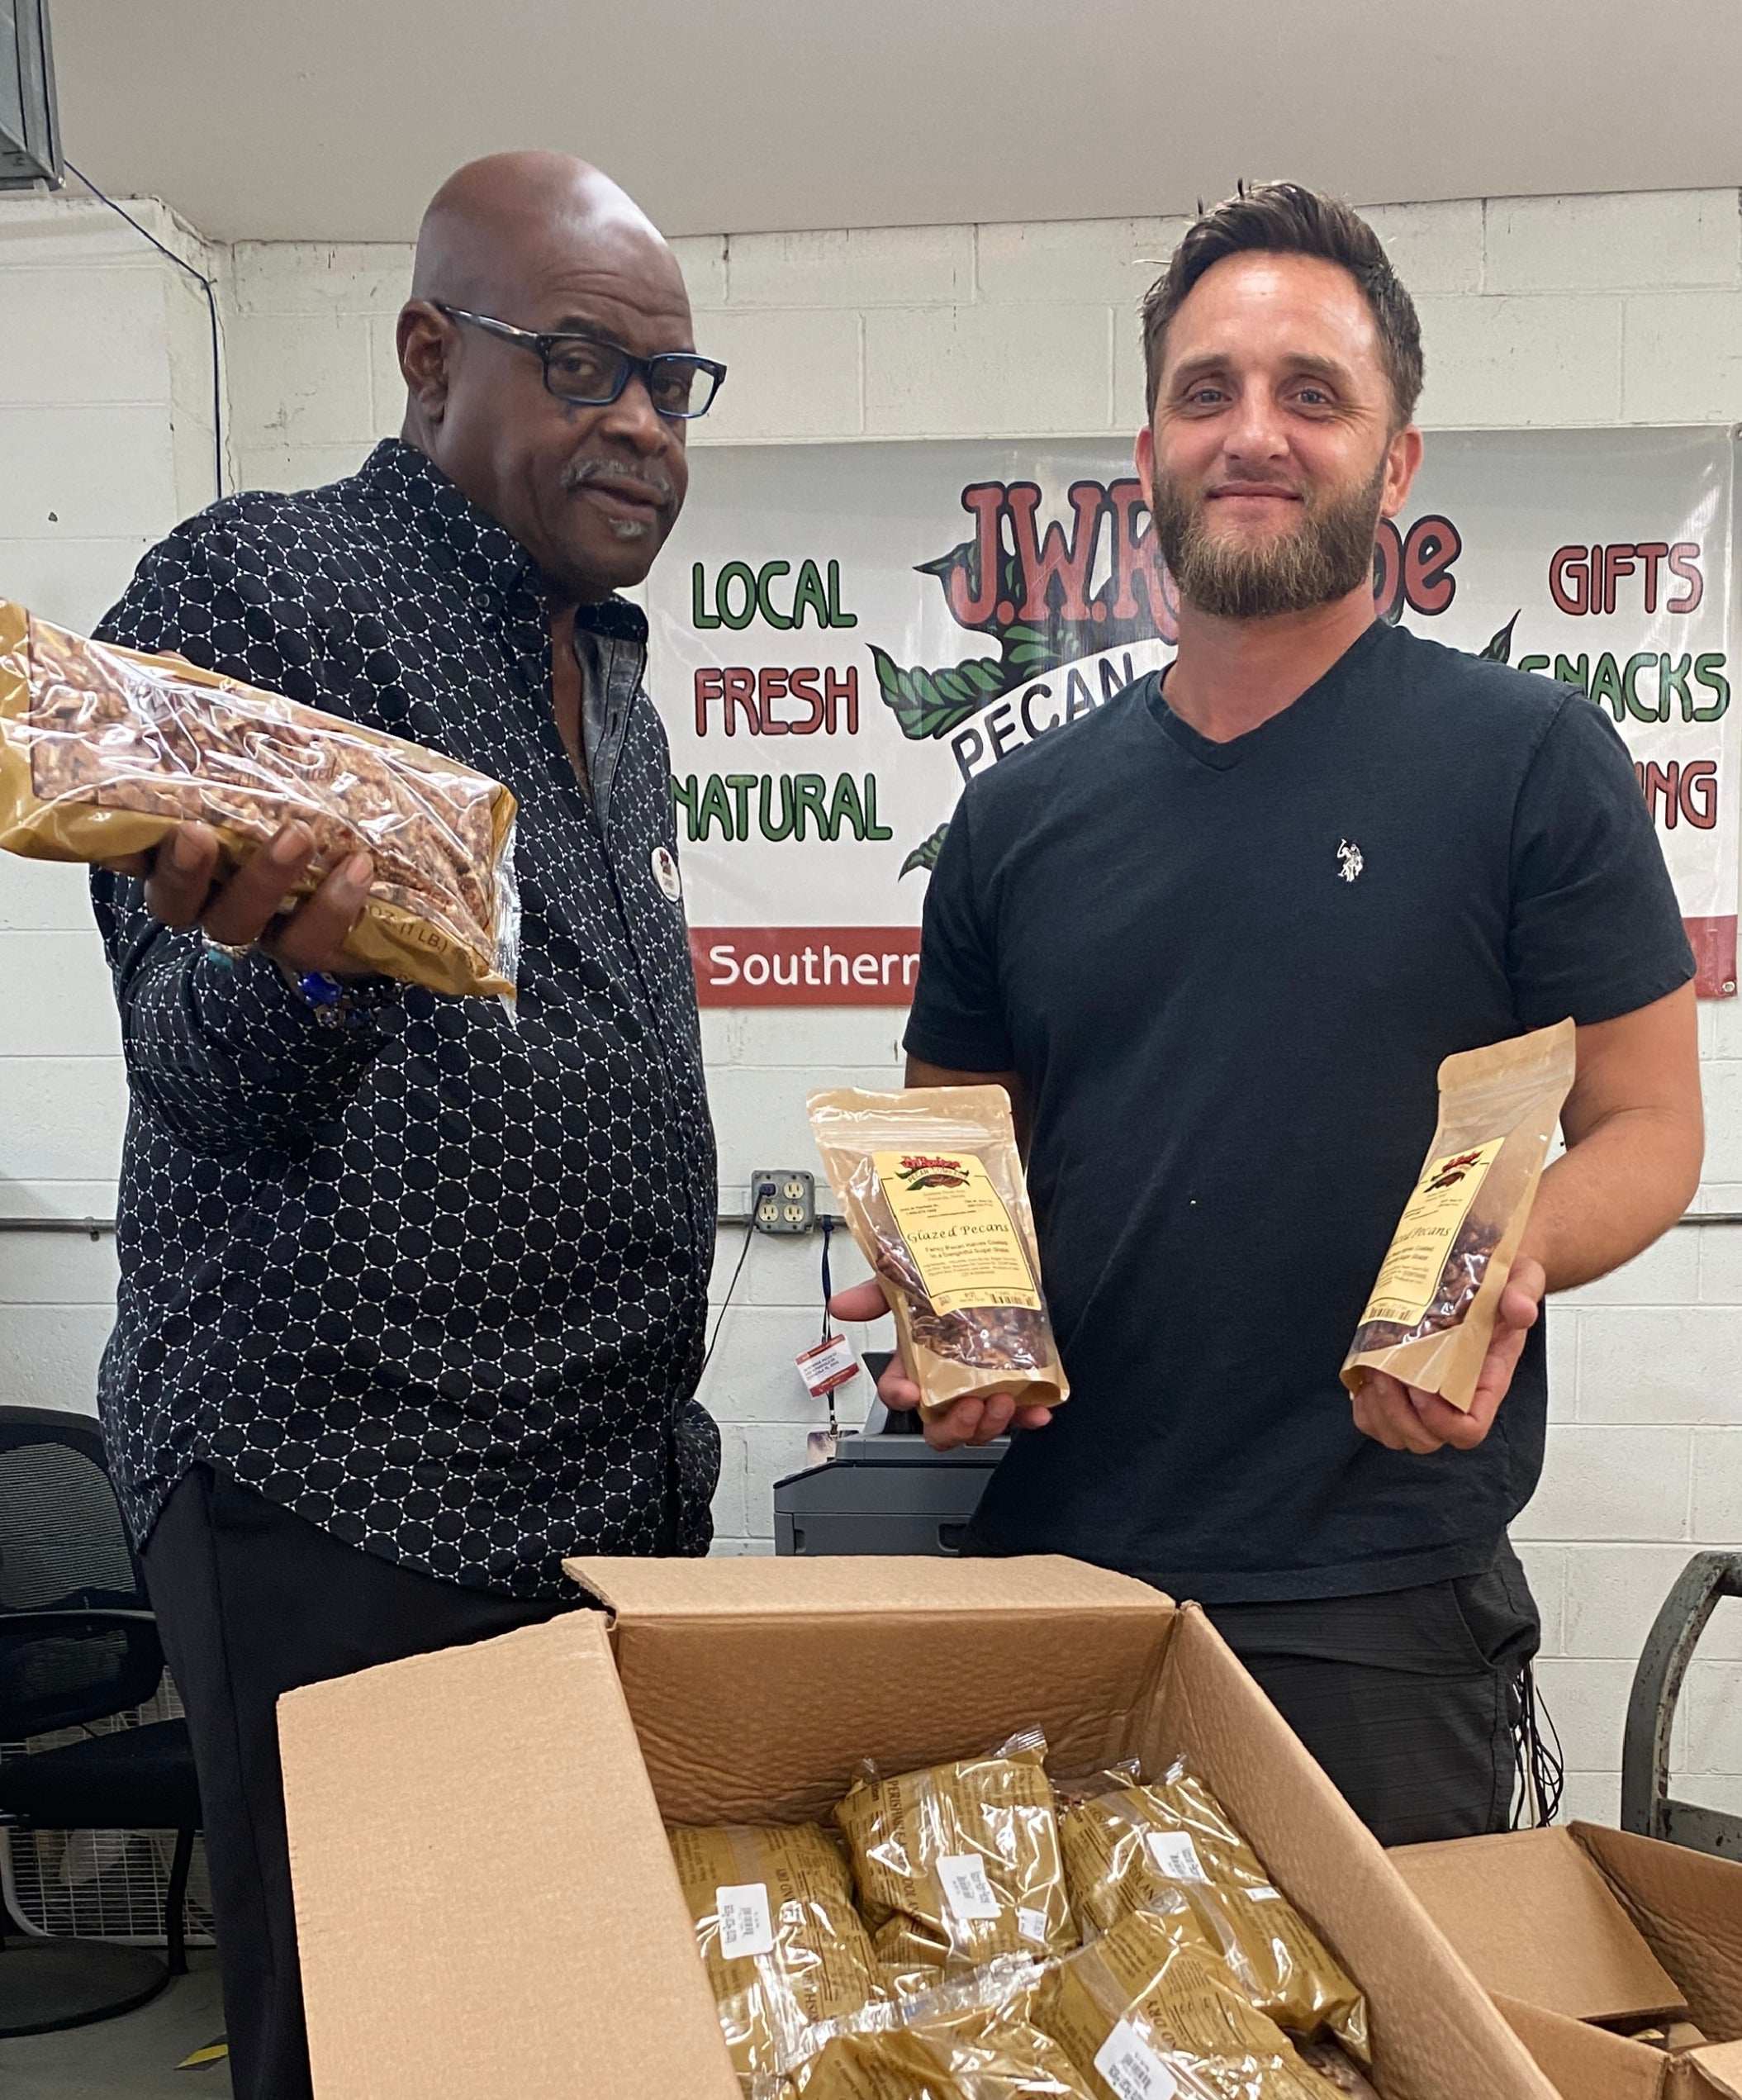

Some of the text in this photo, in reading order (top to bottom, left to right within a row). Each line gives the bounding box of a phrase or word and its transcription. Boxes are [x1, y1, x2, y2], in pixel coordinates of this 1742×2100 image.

[692, 559, 857, 630] LOCAL
[1549, 541, 1704, 616] GIFTS
[694, 666, 859, 737] FRESH
[950, 651, 1134, 785] PECAN
[1517, 651, 1731, 724] NACKS
[671, 772, 894, 843] NATURAL
[709, 944, 921, 986] Southern
[909, 1168, 930, 1184] PECAN
[907, 1223, 1009, 1244] Glazed Pecans
